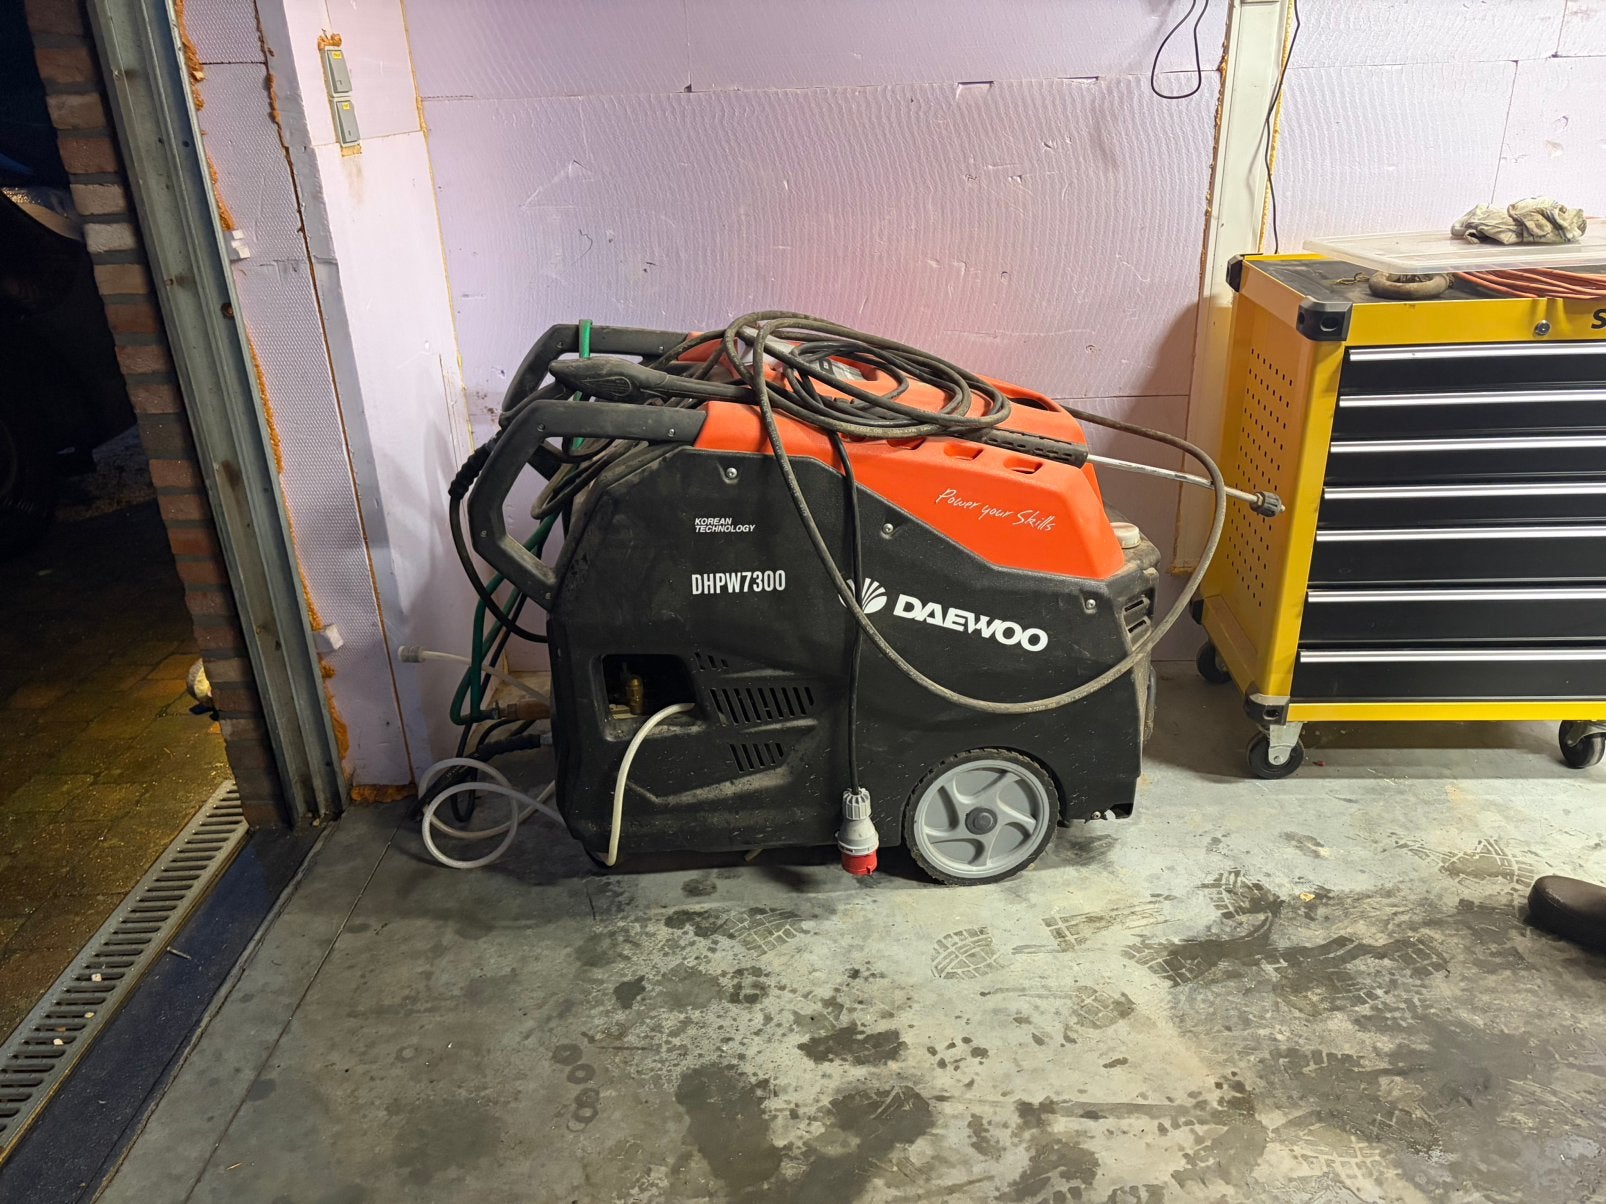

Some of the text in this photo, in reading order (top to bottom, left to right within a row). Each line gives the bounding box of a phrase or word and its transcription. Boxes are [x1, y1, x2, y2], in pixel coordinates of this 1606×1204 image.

[694, 517, 733, 525] KOREAN
[936, 488, 1056, 532] Power your Skills
[695, 525, 756, 533] TECHNOLOGY
[691, 570, 786, 595] DHPW7300
[893, 594, 1049, 652] DAEWOO
